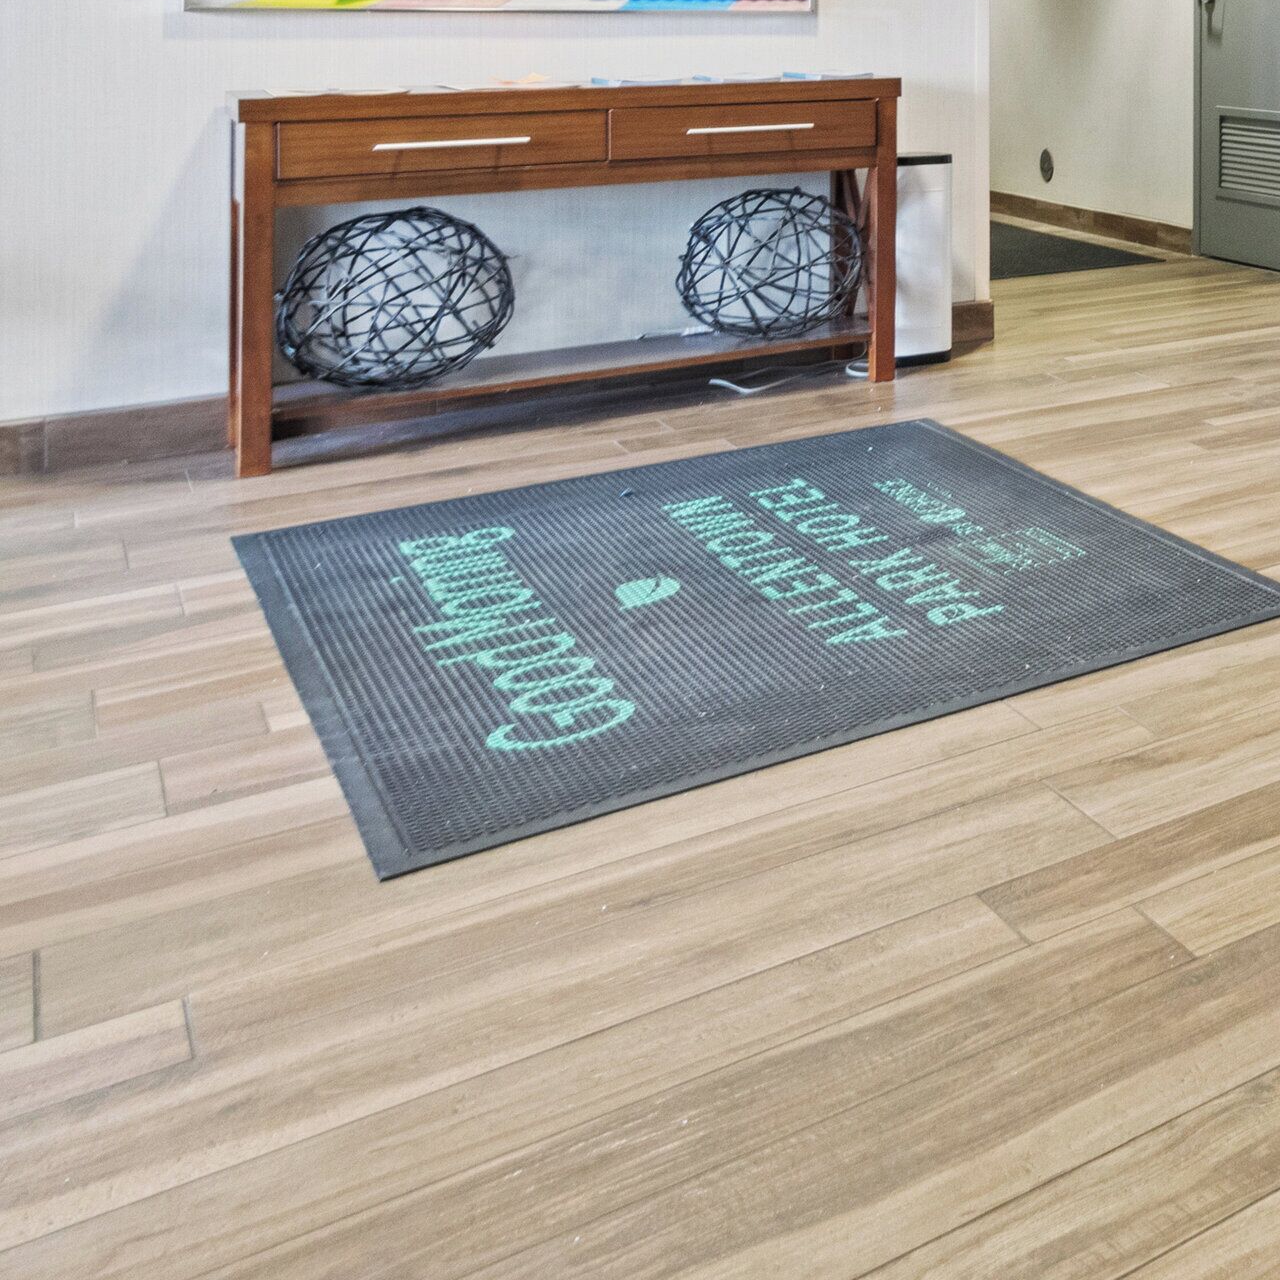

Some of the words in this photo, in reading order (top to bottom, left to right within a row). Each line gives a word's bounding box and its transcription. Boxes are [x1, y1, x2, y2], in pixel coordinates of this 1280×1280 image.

[749, 478, 889, 552] HOTEL
[662, 495, 908, 646] ALLENTOWN
[849, 547, 1005, 626] PARK
[435, 631, 636, 751] Good
